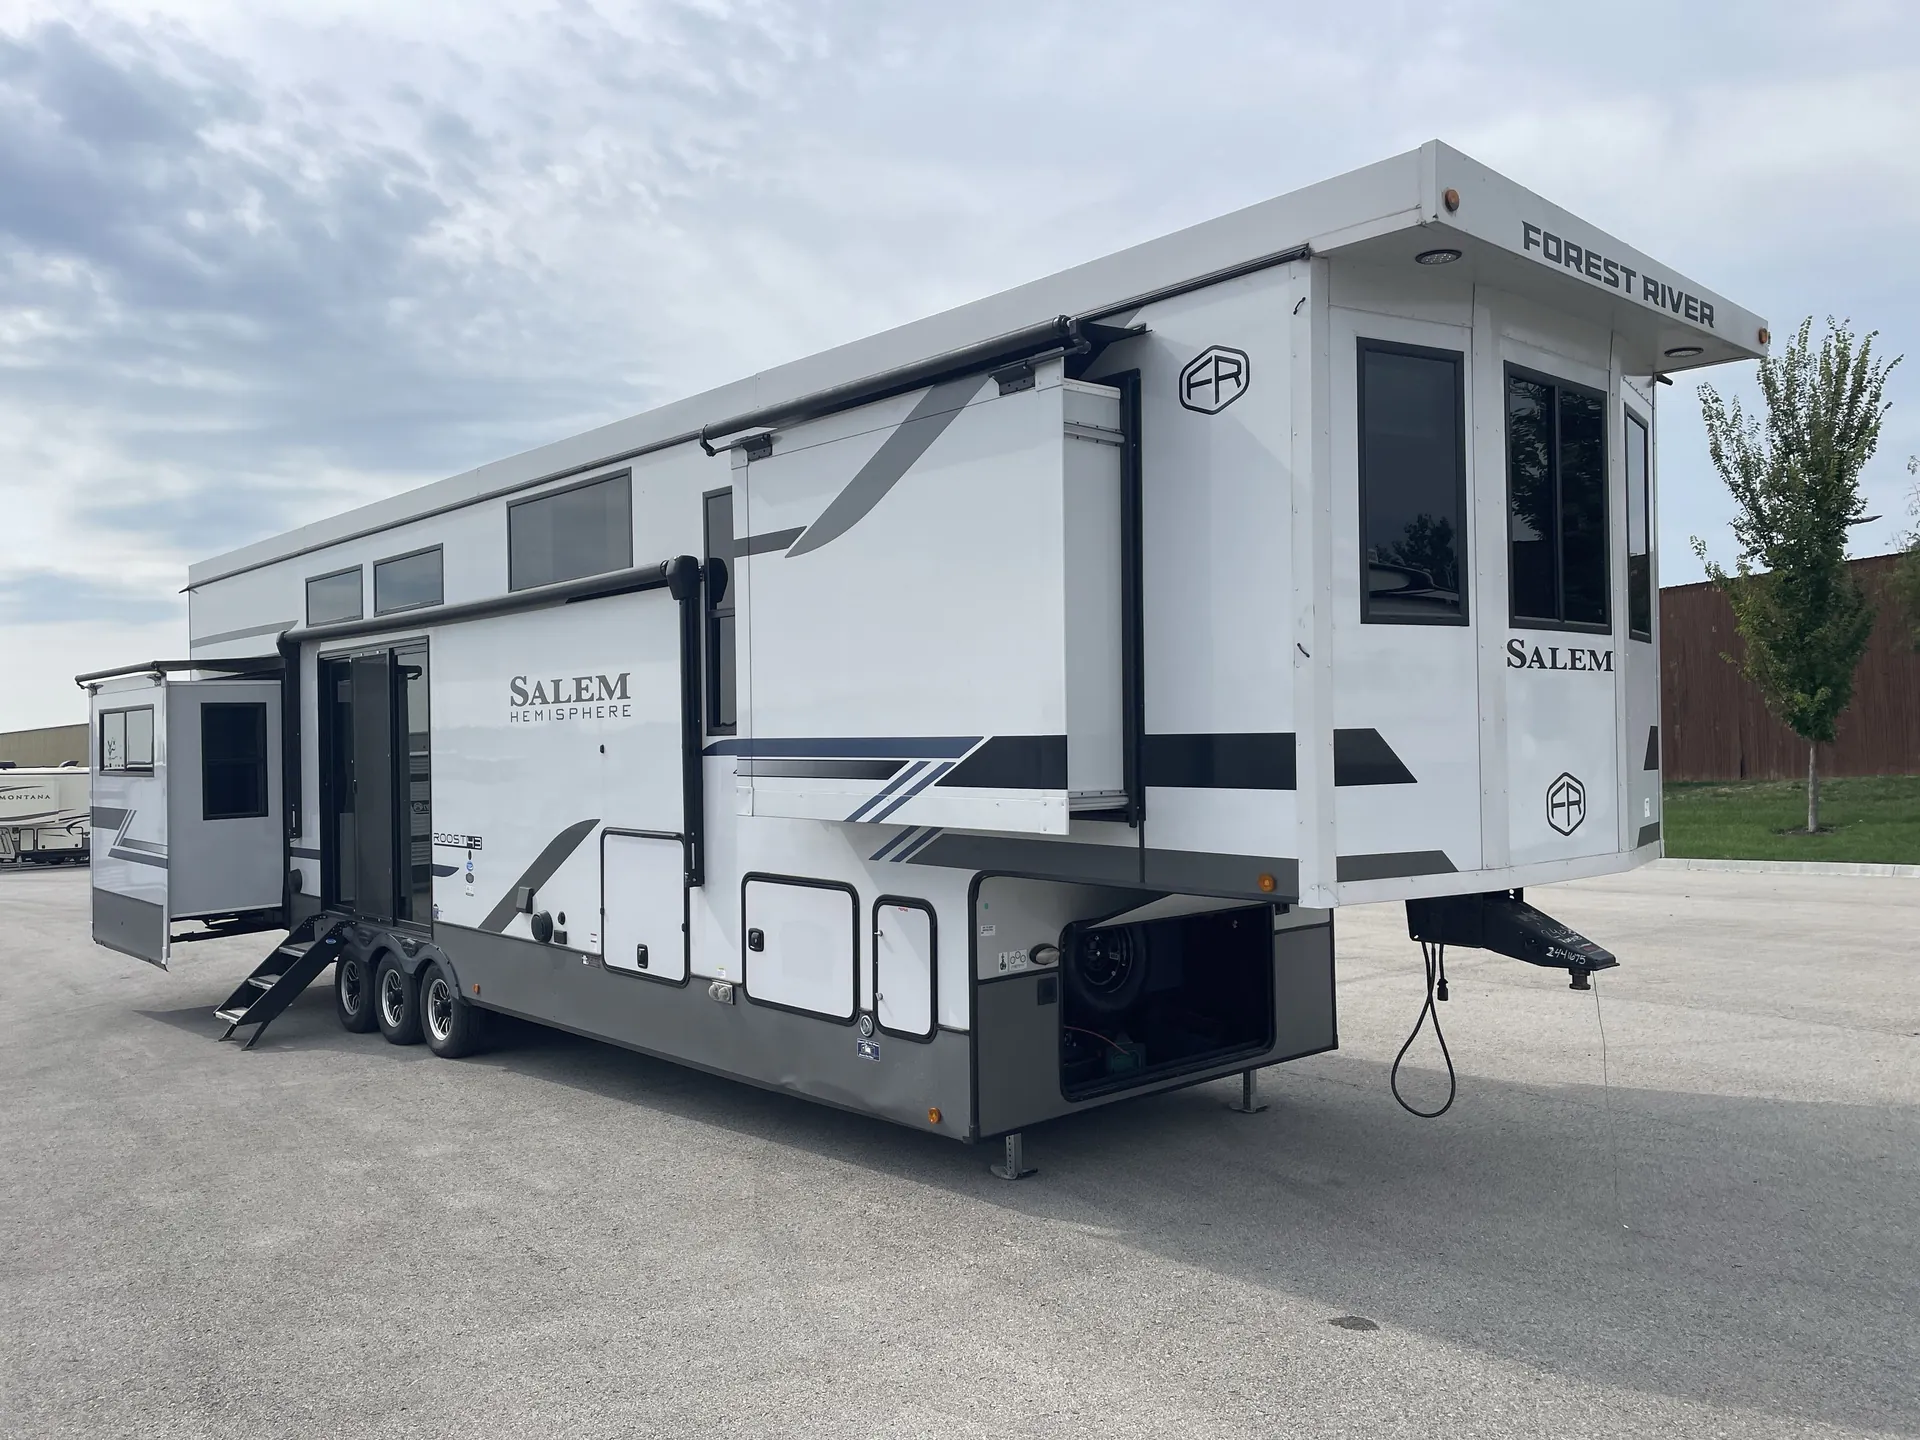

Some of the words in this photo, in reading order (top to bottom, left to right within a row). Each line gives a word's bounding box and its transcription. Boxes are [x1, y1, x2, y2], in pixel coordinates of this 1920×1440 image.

[1521, 220, 1637, 294] FOREST
[1641, 274, 1715, 329] RIVER
[1506, 638, 1615, 672] SALEM
[509, 672, 632, 707] SALEM
[509, 704, 632, 723] HEMISPHERE
